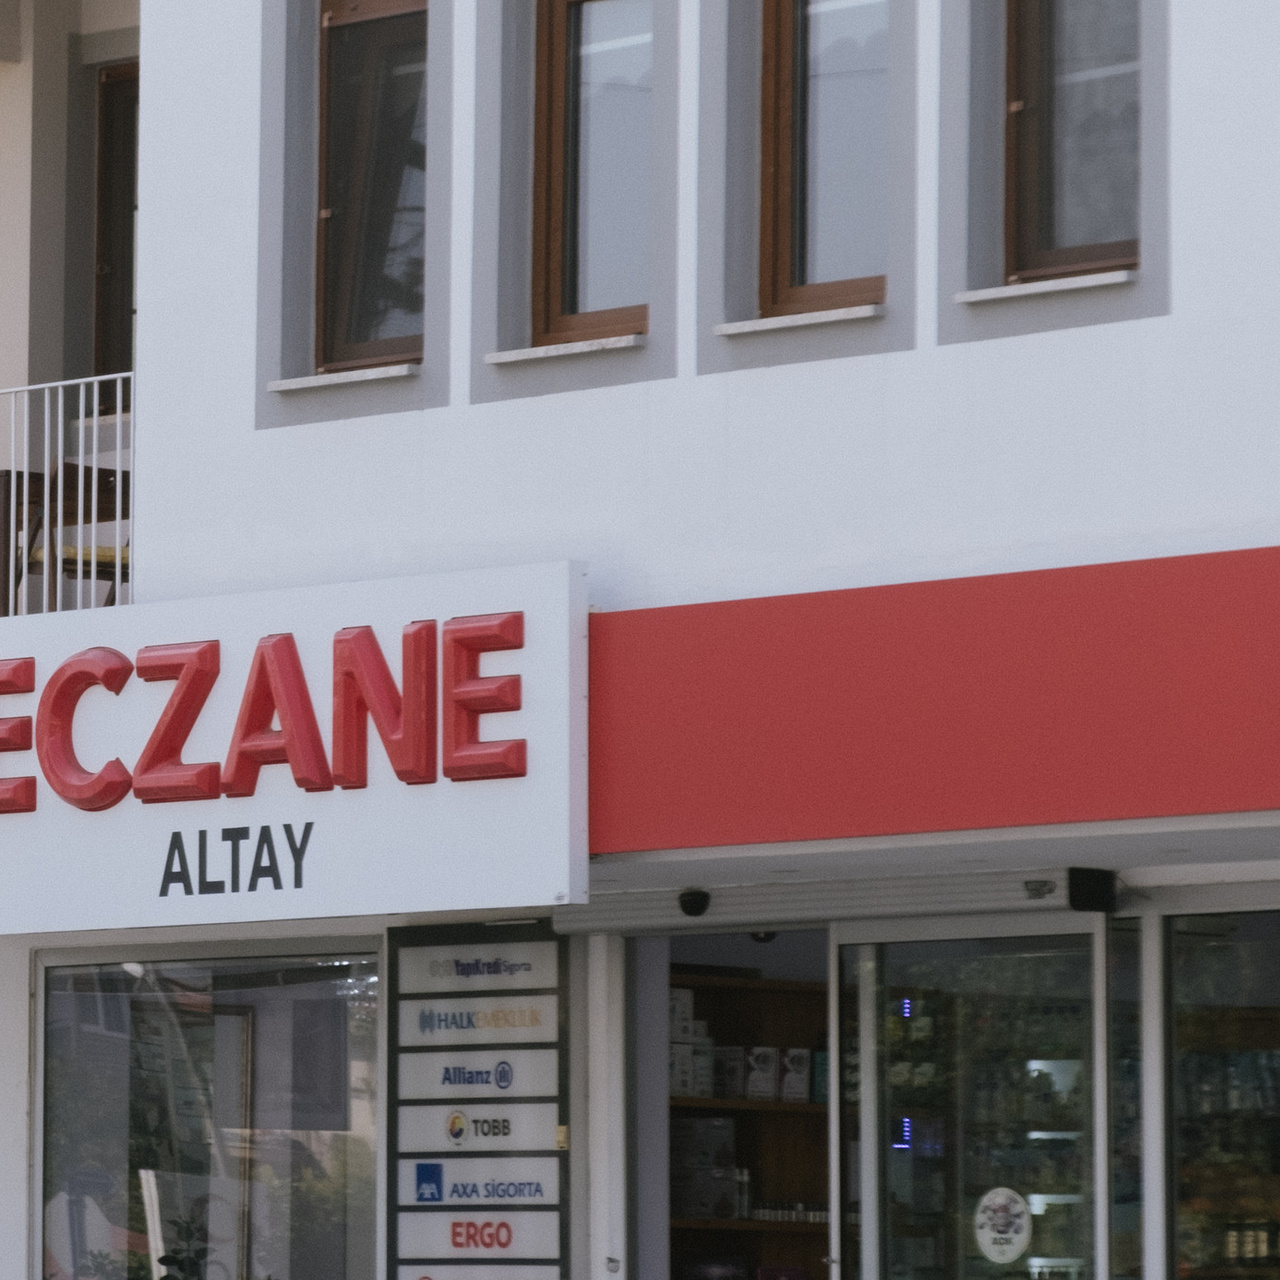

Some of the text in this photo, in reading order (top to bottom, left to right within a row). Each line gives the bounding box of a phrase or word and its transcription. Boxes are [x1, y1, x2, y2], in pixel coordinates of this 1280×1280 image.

[158, 821, 314, 898] ALTAY
[442, 1066, 491, 1085] Allianz
[472, 1118, 511, 1137] TOBB
[449, 1178, 544, 1198] AXA SİGORTA
[451, 1221, 513, 1249] ERGO
